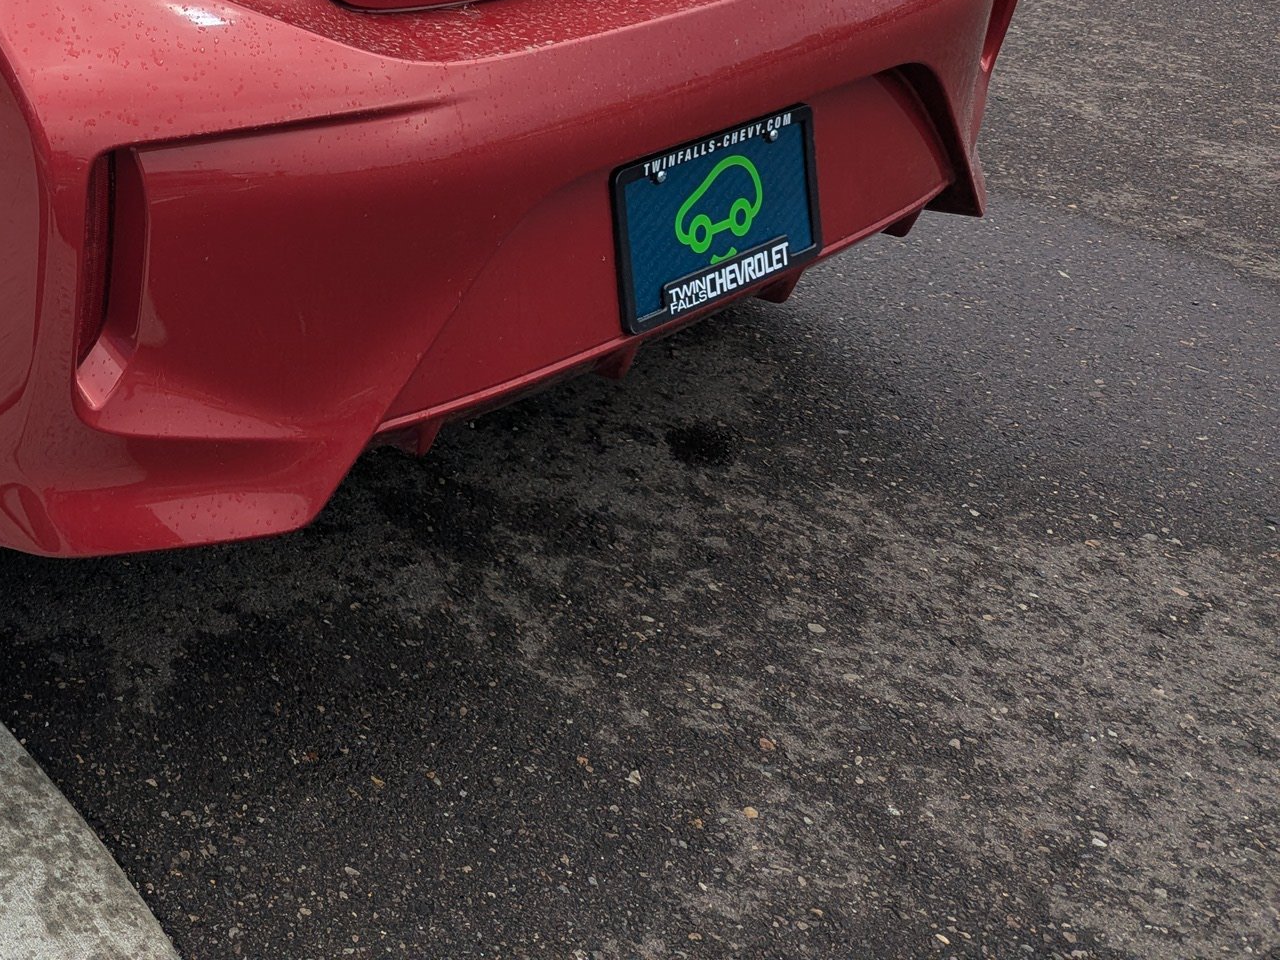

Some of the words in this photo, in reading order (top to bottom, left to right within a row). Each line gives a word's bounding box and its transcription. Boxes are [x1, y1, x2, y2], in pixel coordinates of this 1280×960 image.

[643, 112, 792, 177] TWINFALLS-CHEVY.COM
[669, 276, 708, 302] TWIN
[706, 242, 790, 299] CHEVROLET
[670, 289, 708, 315] FALLS
